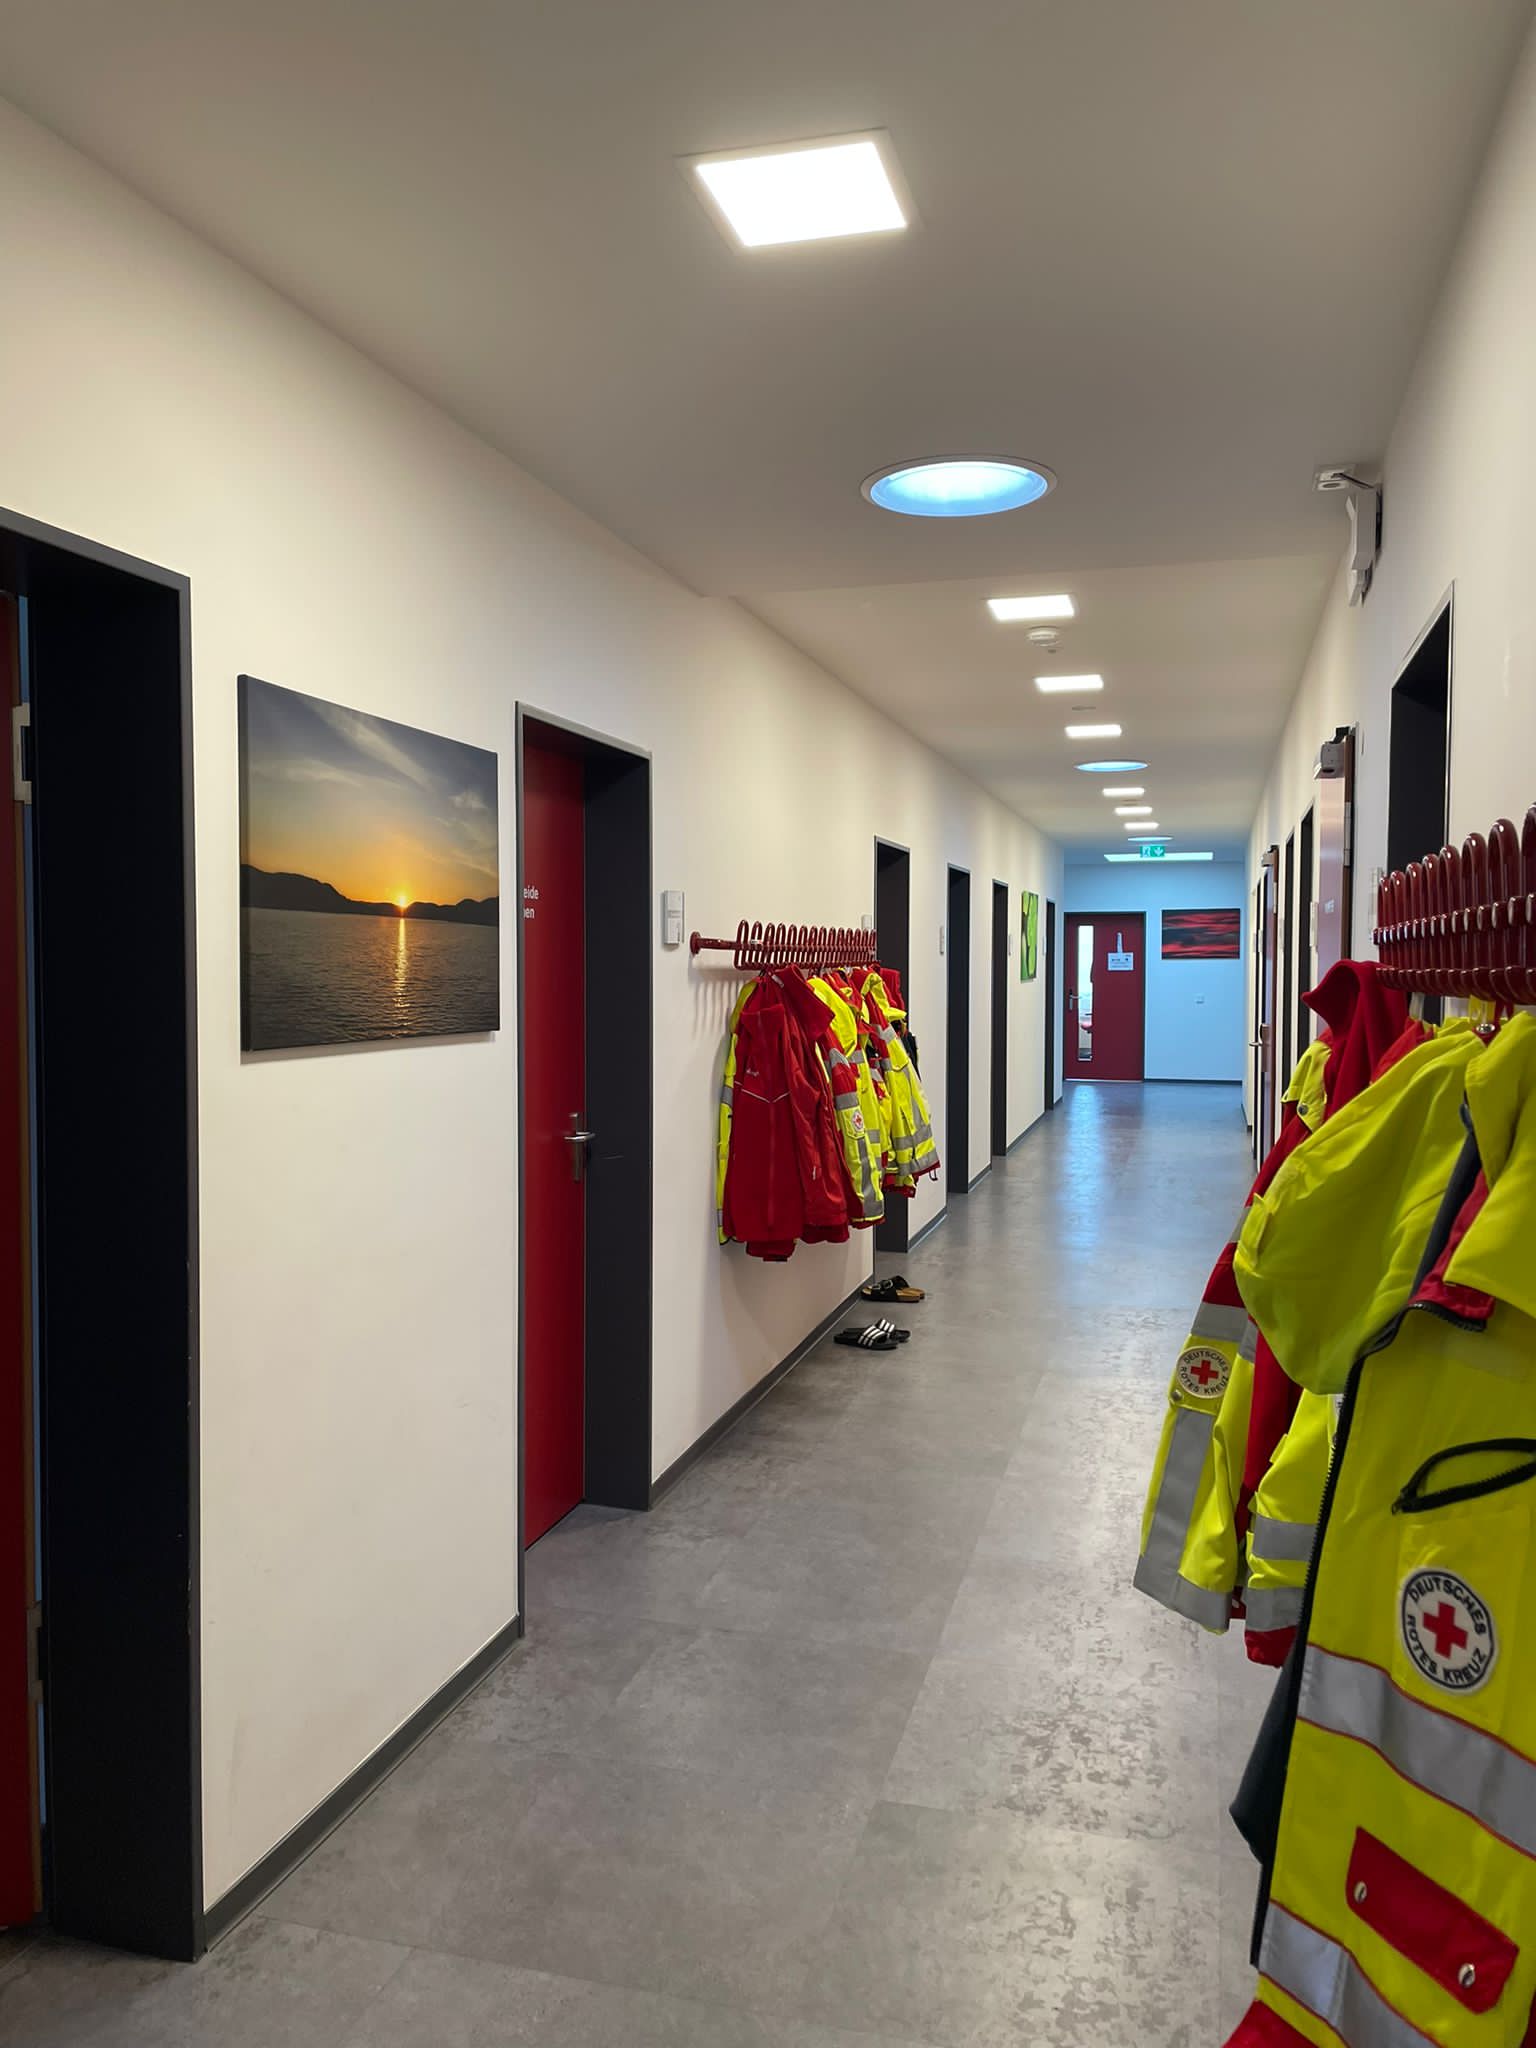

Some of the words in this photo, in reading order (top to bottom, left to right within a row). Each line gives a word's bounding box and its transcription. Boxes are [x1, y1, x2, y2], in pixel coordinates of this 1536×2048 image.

[1180, 1366, 1199, 1392] ROTES
[1203, 1376, 1228, 1394] KREUZ
[1183, 1351, 1228, 1371] DEUTSCHES
[1408, 1577, 1486, 1635] DEUTSCHES
[1406, 1614, 1438, 1675] ROTES
[1442, 1647, 1487, 1683] KREUZ
